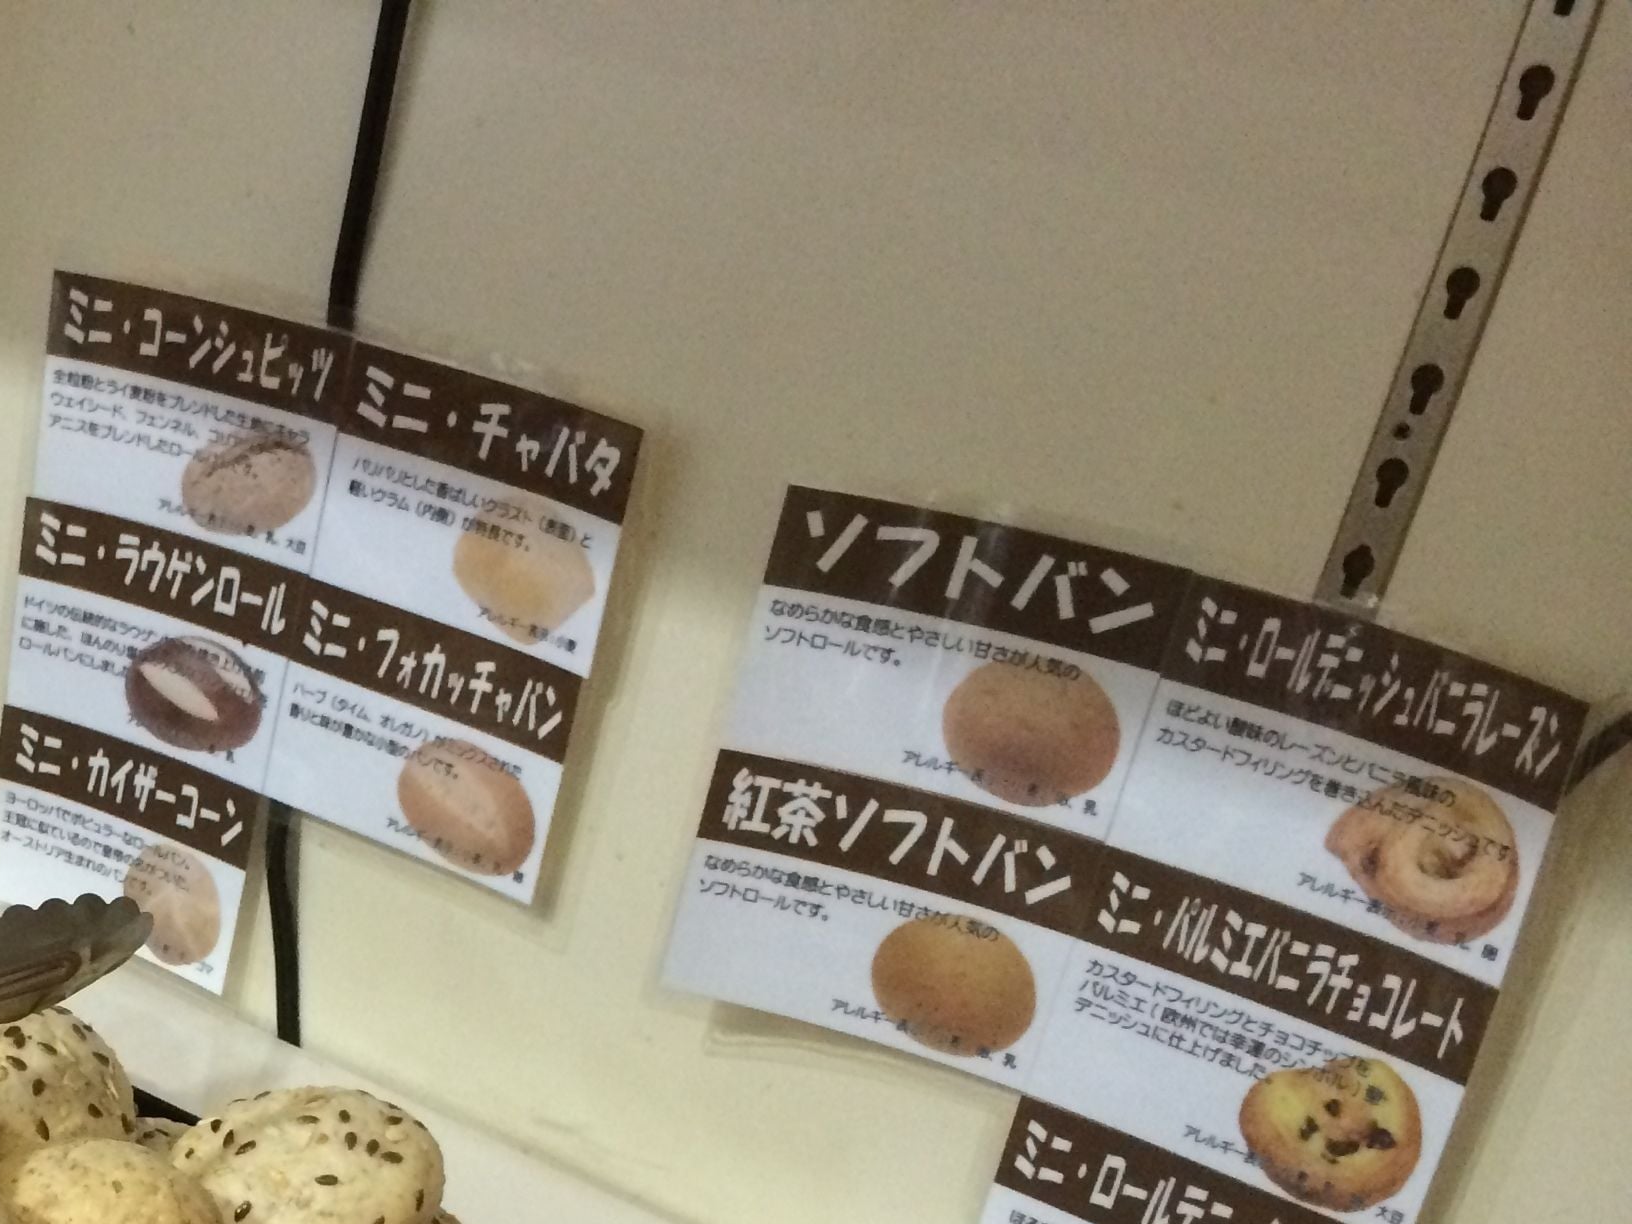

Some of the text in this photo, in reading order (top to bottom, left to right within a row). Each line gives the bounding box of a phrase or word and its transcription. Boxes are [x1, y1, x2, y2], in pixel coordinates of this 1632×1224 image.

[63, 287, 334, 403] ミニ・コーンシュピッツ
[355, 364, 623, 501] ミニ・チャバタ
[34, 510, 292, 637] ミニ・ラウゲンロール
[793, 503, 1165, 645] ソフトバン
[763, 620, 906, 669] ソフトロールです。
[1183, 594, 1571, 782] ミニ・ロールデニッシュバニラレーズン
[15, 721, 248, 851] ミニ・カイザーコーン
[720, 763, 1082, 914] 紅茶ソフトバン
[697, 875, 832, 924] ソフトロールです。
[1094, 867, 1475, 1065] ミニ・パルミエバニラチョコレート
